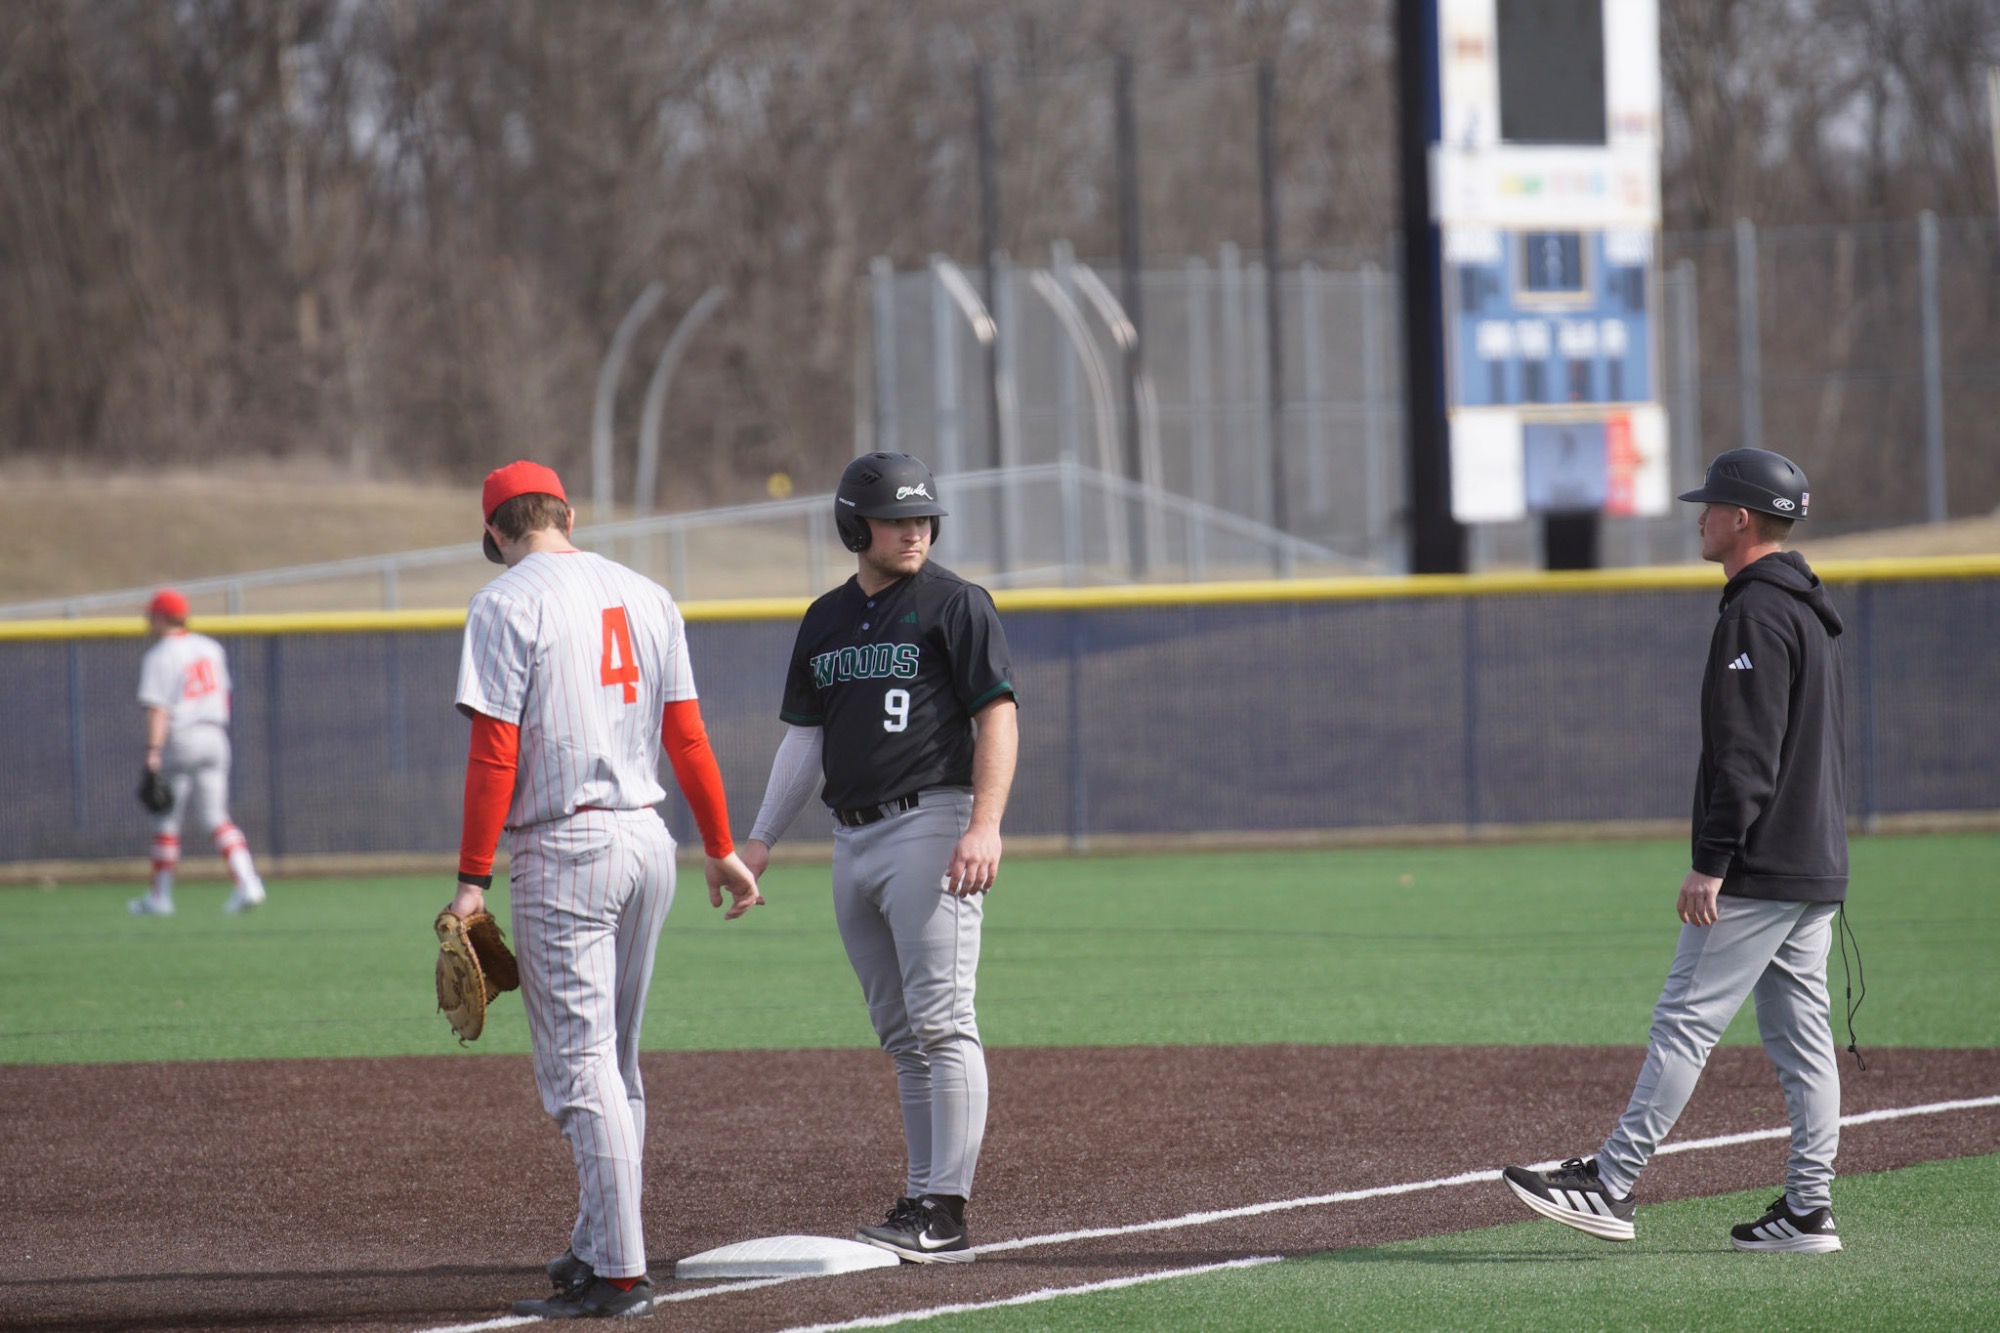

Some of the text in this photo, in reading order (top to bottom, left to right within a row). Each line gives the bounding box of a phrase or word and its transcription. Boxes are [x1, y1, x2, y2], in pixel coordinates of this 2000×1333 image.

[600, 606, 639, 704] 4
[810, 643, 920, 689] WOODS
[884, 689, 910, 732] 9
